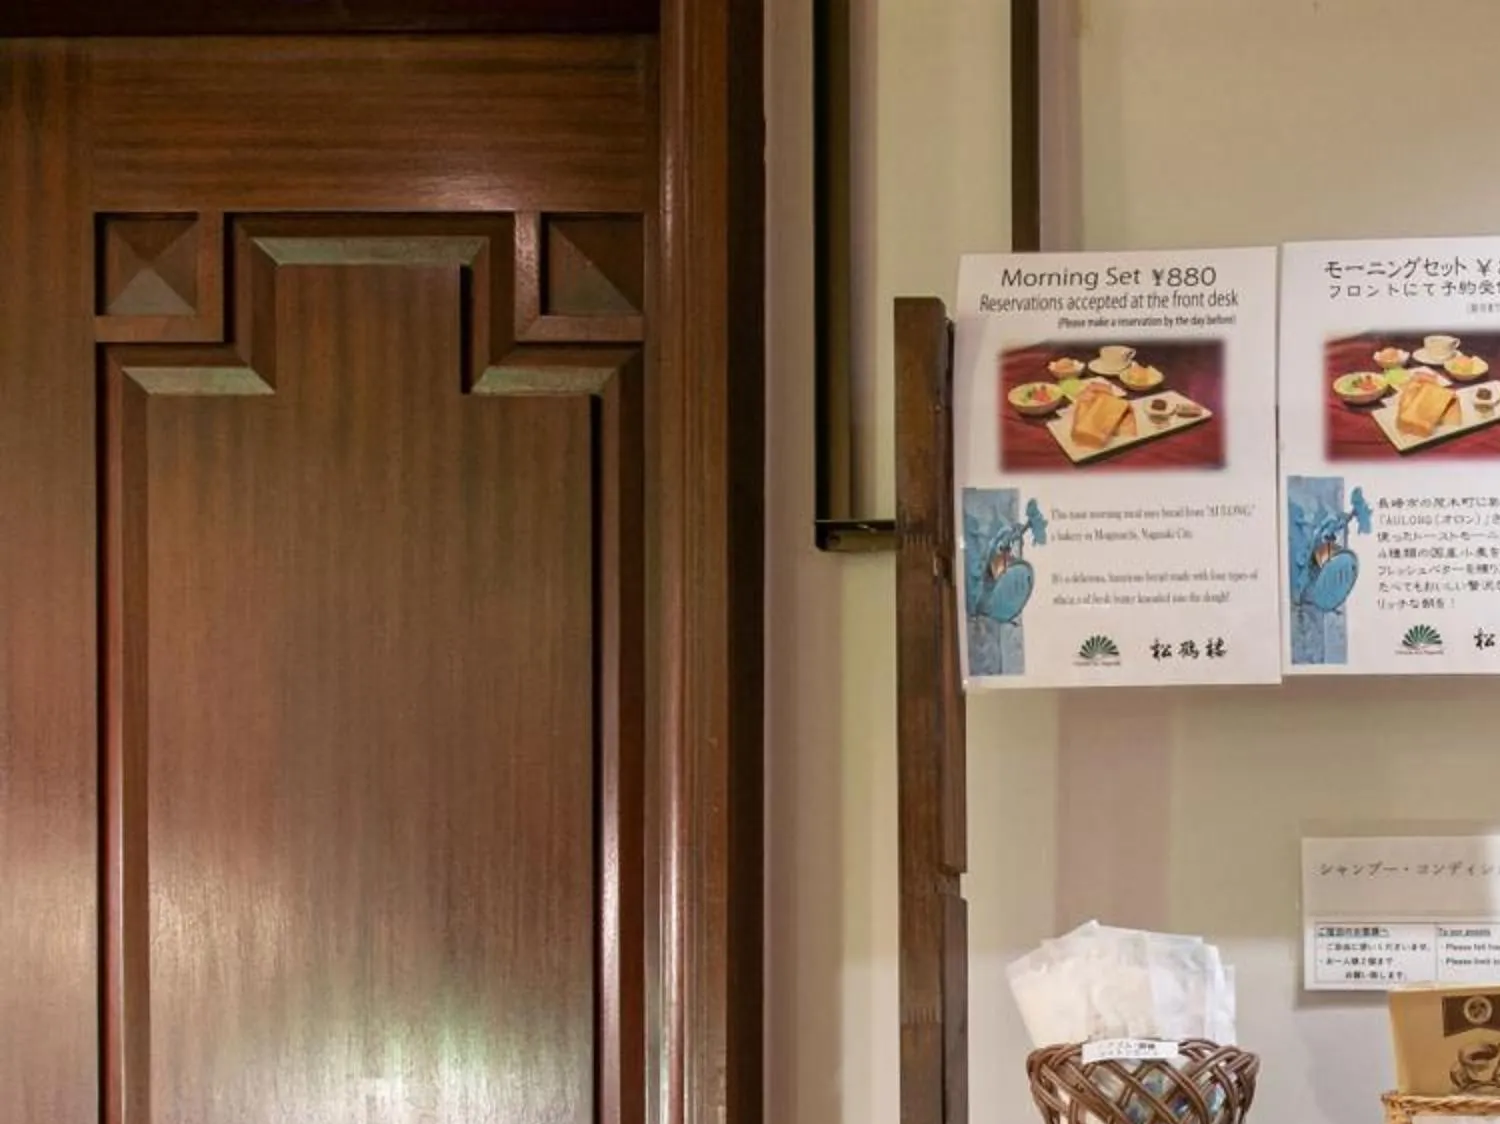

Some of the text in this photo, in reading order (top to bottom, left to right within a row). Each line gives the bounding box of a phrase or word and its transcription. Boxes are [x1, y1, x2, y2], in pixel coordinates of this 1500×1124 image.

[1000, 266, 1217, 290] Morning Set ¥880
[1324, 256, 1467, 279] モーニングセット
[979, 289, 1239, 311] Reservations accepted at the front desk
